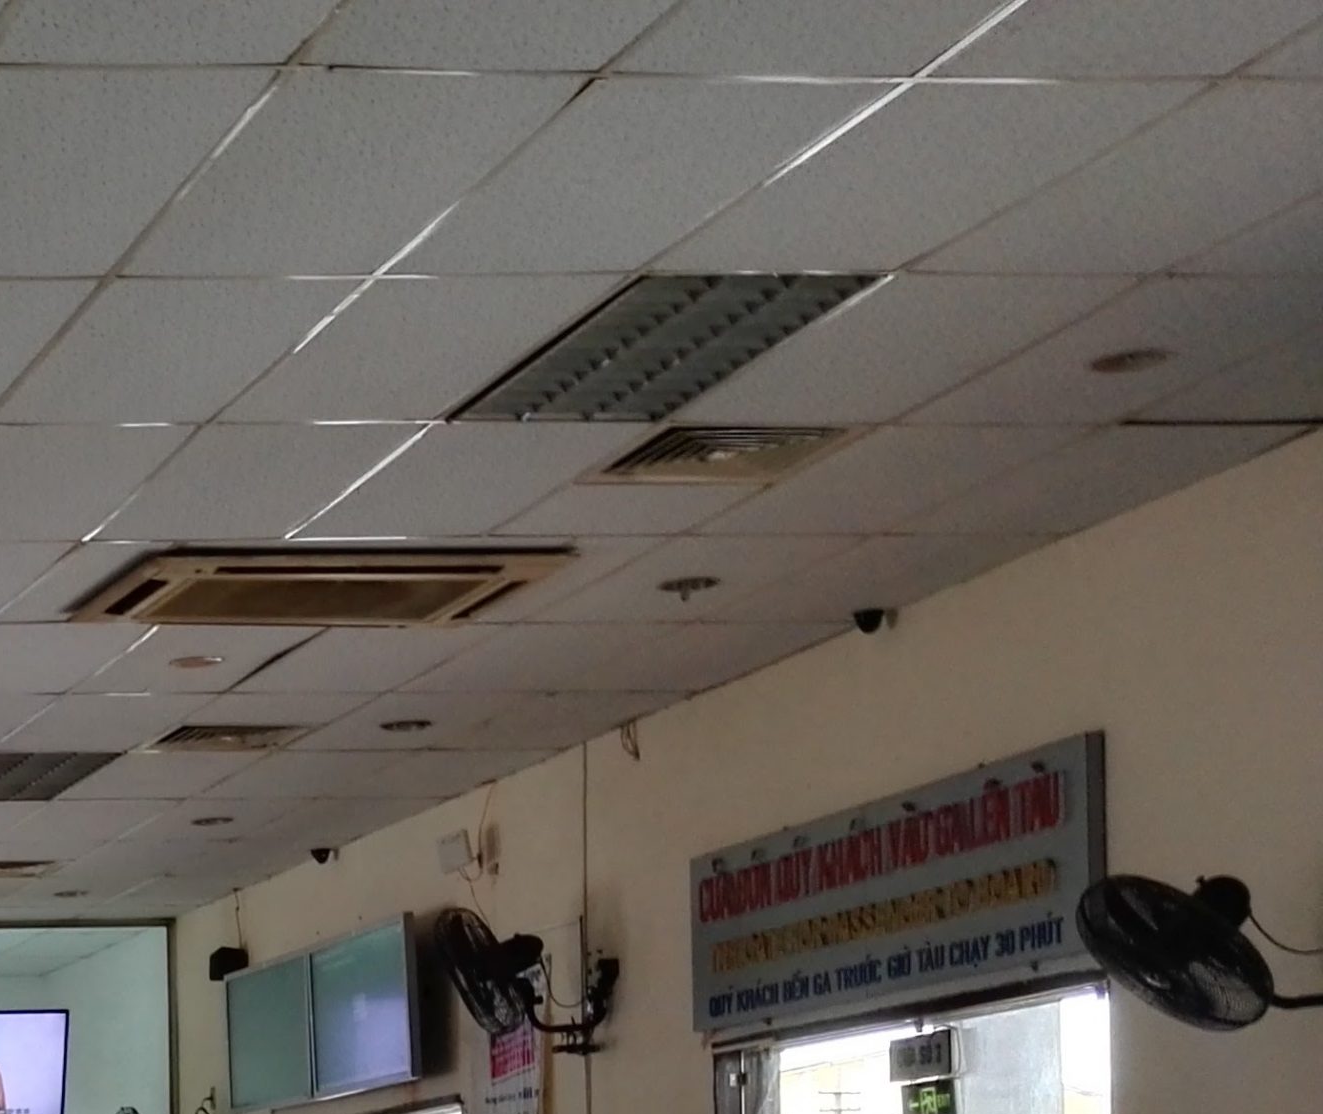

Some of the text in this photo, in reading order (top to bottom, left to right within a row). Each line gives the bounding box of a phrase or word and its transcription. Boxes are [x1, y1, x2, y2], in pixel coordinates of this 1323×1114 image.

[708, 985, 734, 1018] QUÝ
[736, 977, 780, 1014] KHÁCH
[813, 969, 833, 996] GA
[834, 954, 883, 992] TRƯỚC
[887, 944, 912, 981] GIỜ
[918, 940, 946, 974] TÀU
[949, 933, 992, 968] CHẠY
[995, 928, 1017, 959] 30
[1019, 911, 1064, 949] PHÚT
